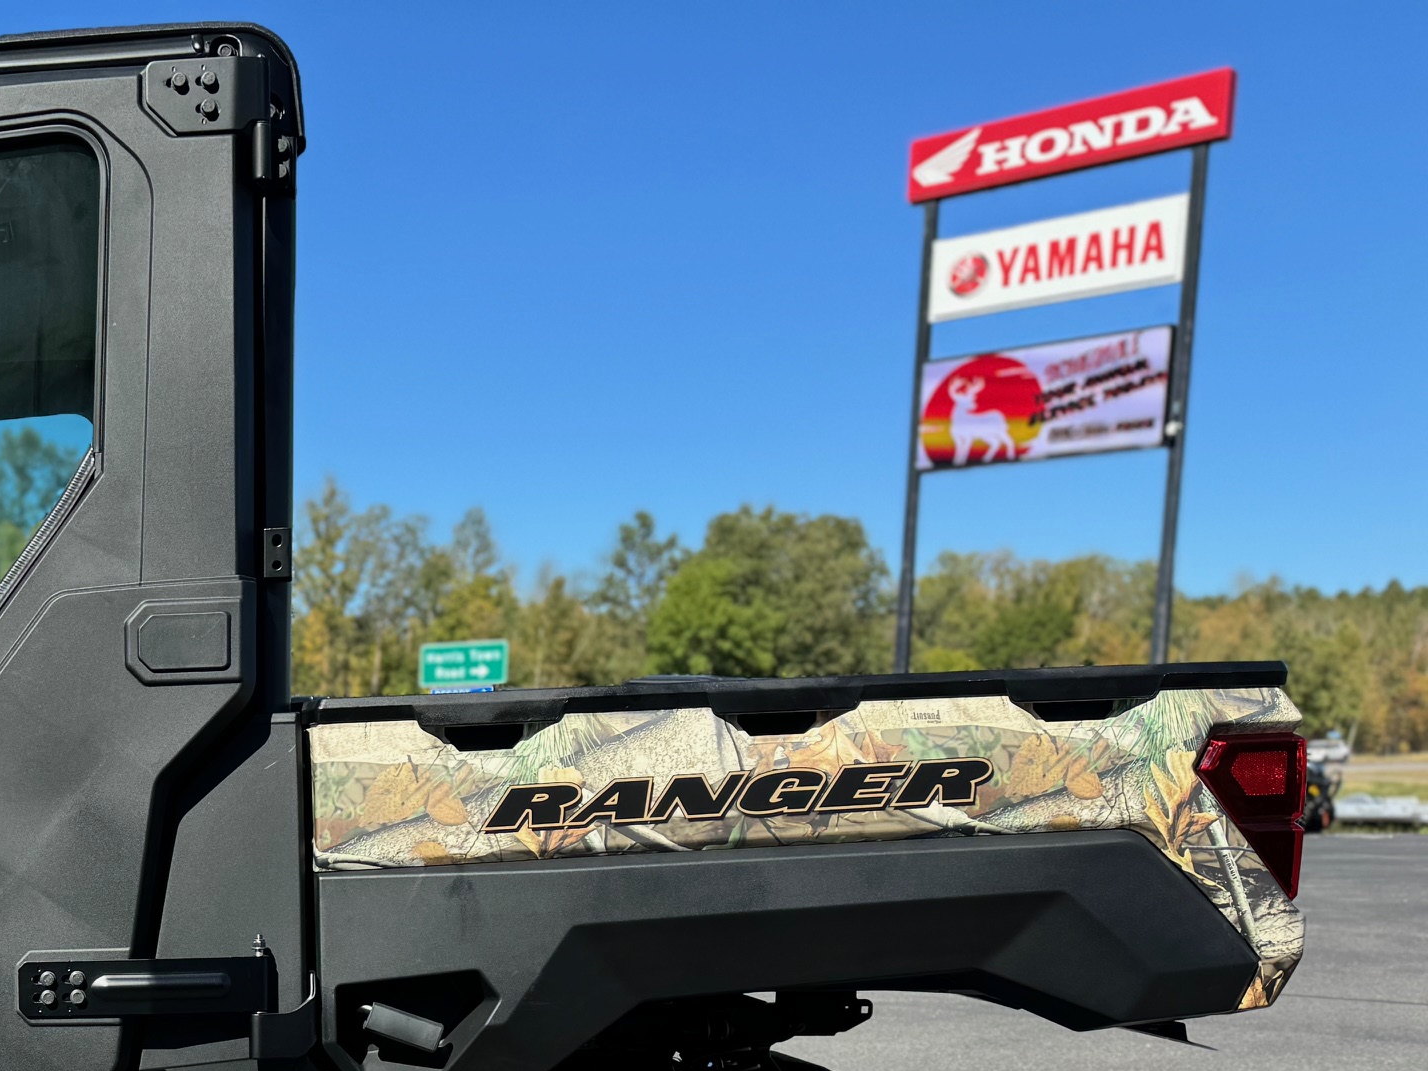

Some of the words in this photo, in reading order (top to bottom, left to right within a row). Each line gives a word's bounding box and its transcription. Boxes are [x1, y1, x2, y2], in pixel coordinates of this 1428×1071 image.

[975, 97, 1219, 175] HONDA
[996, 221, 1165, 289] YAMAHA
[480, 756, 995, 833] RANGER
